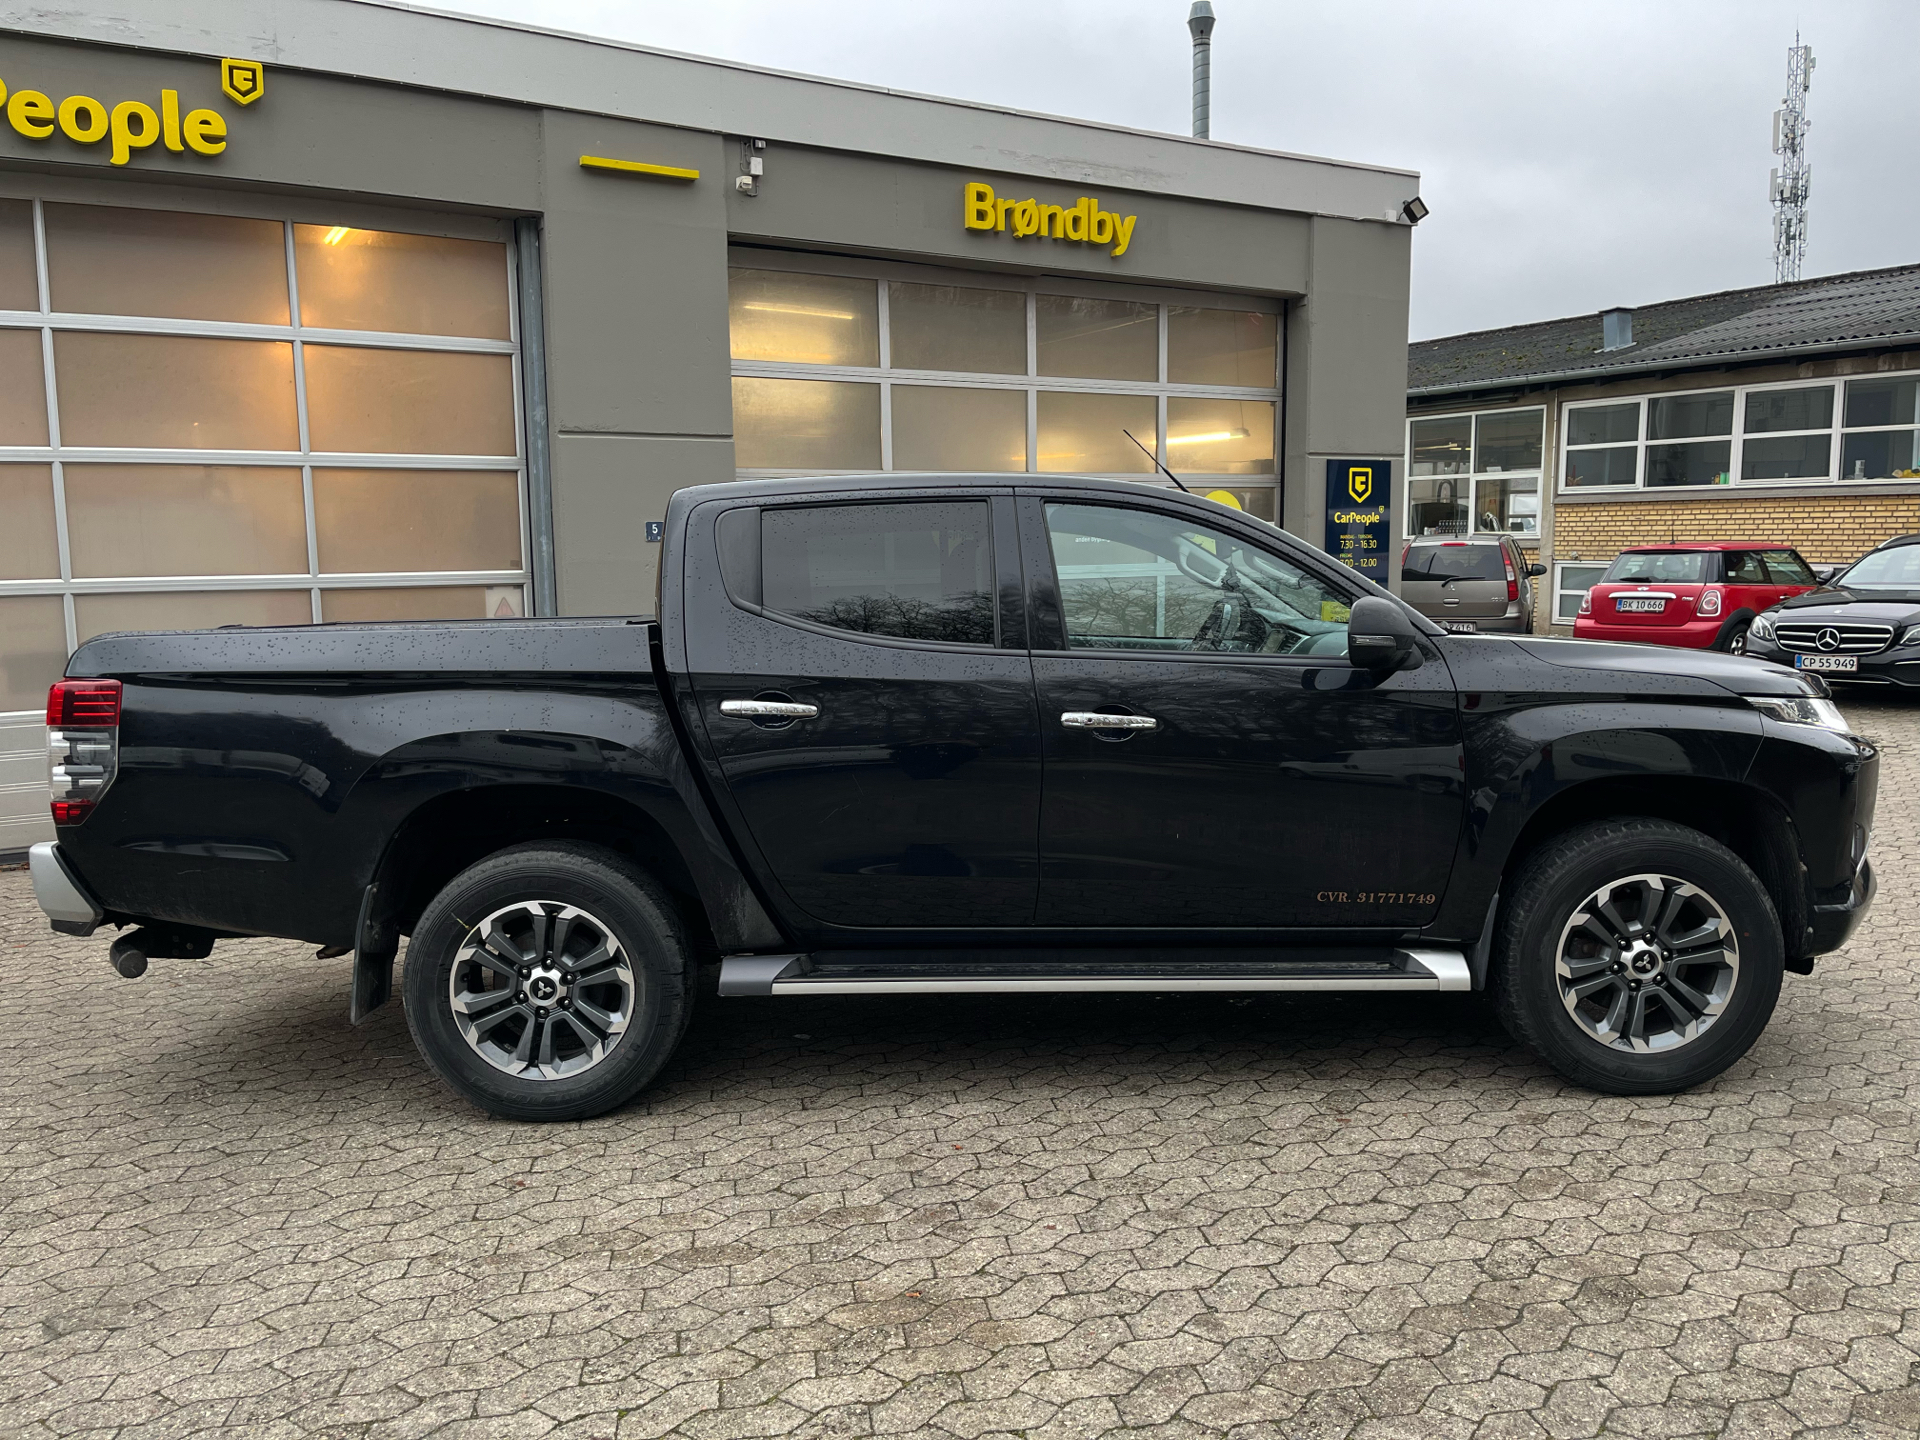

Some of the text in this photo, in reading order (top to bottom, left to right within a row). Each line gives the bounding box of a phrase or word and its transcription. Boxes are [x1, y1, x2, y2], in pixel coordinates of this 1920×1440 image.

[0, 77, 228, 166] eople
[964, 181, 1137, 258] Brøndby
[1334, 511, 1380, 526] CarPeople
[652, 523, 659, 534] 5
[1340, 540, 1354, 549] 7.30
[1360, 539, 1377, 549] 16.30
[1360, 558, 1377, 567] 12.00
[1622, 600, 1663, 609] BK 10 666
[1802, 657, 1855, 669] CP 55 949
[1316, 891, 1436, 905] CVR. 31771749
